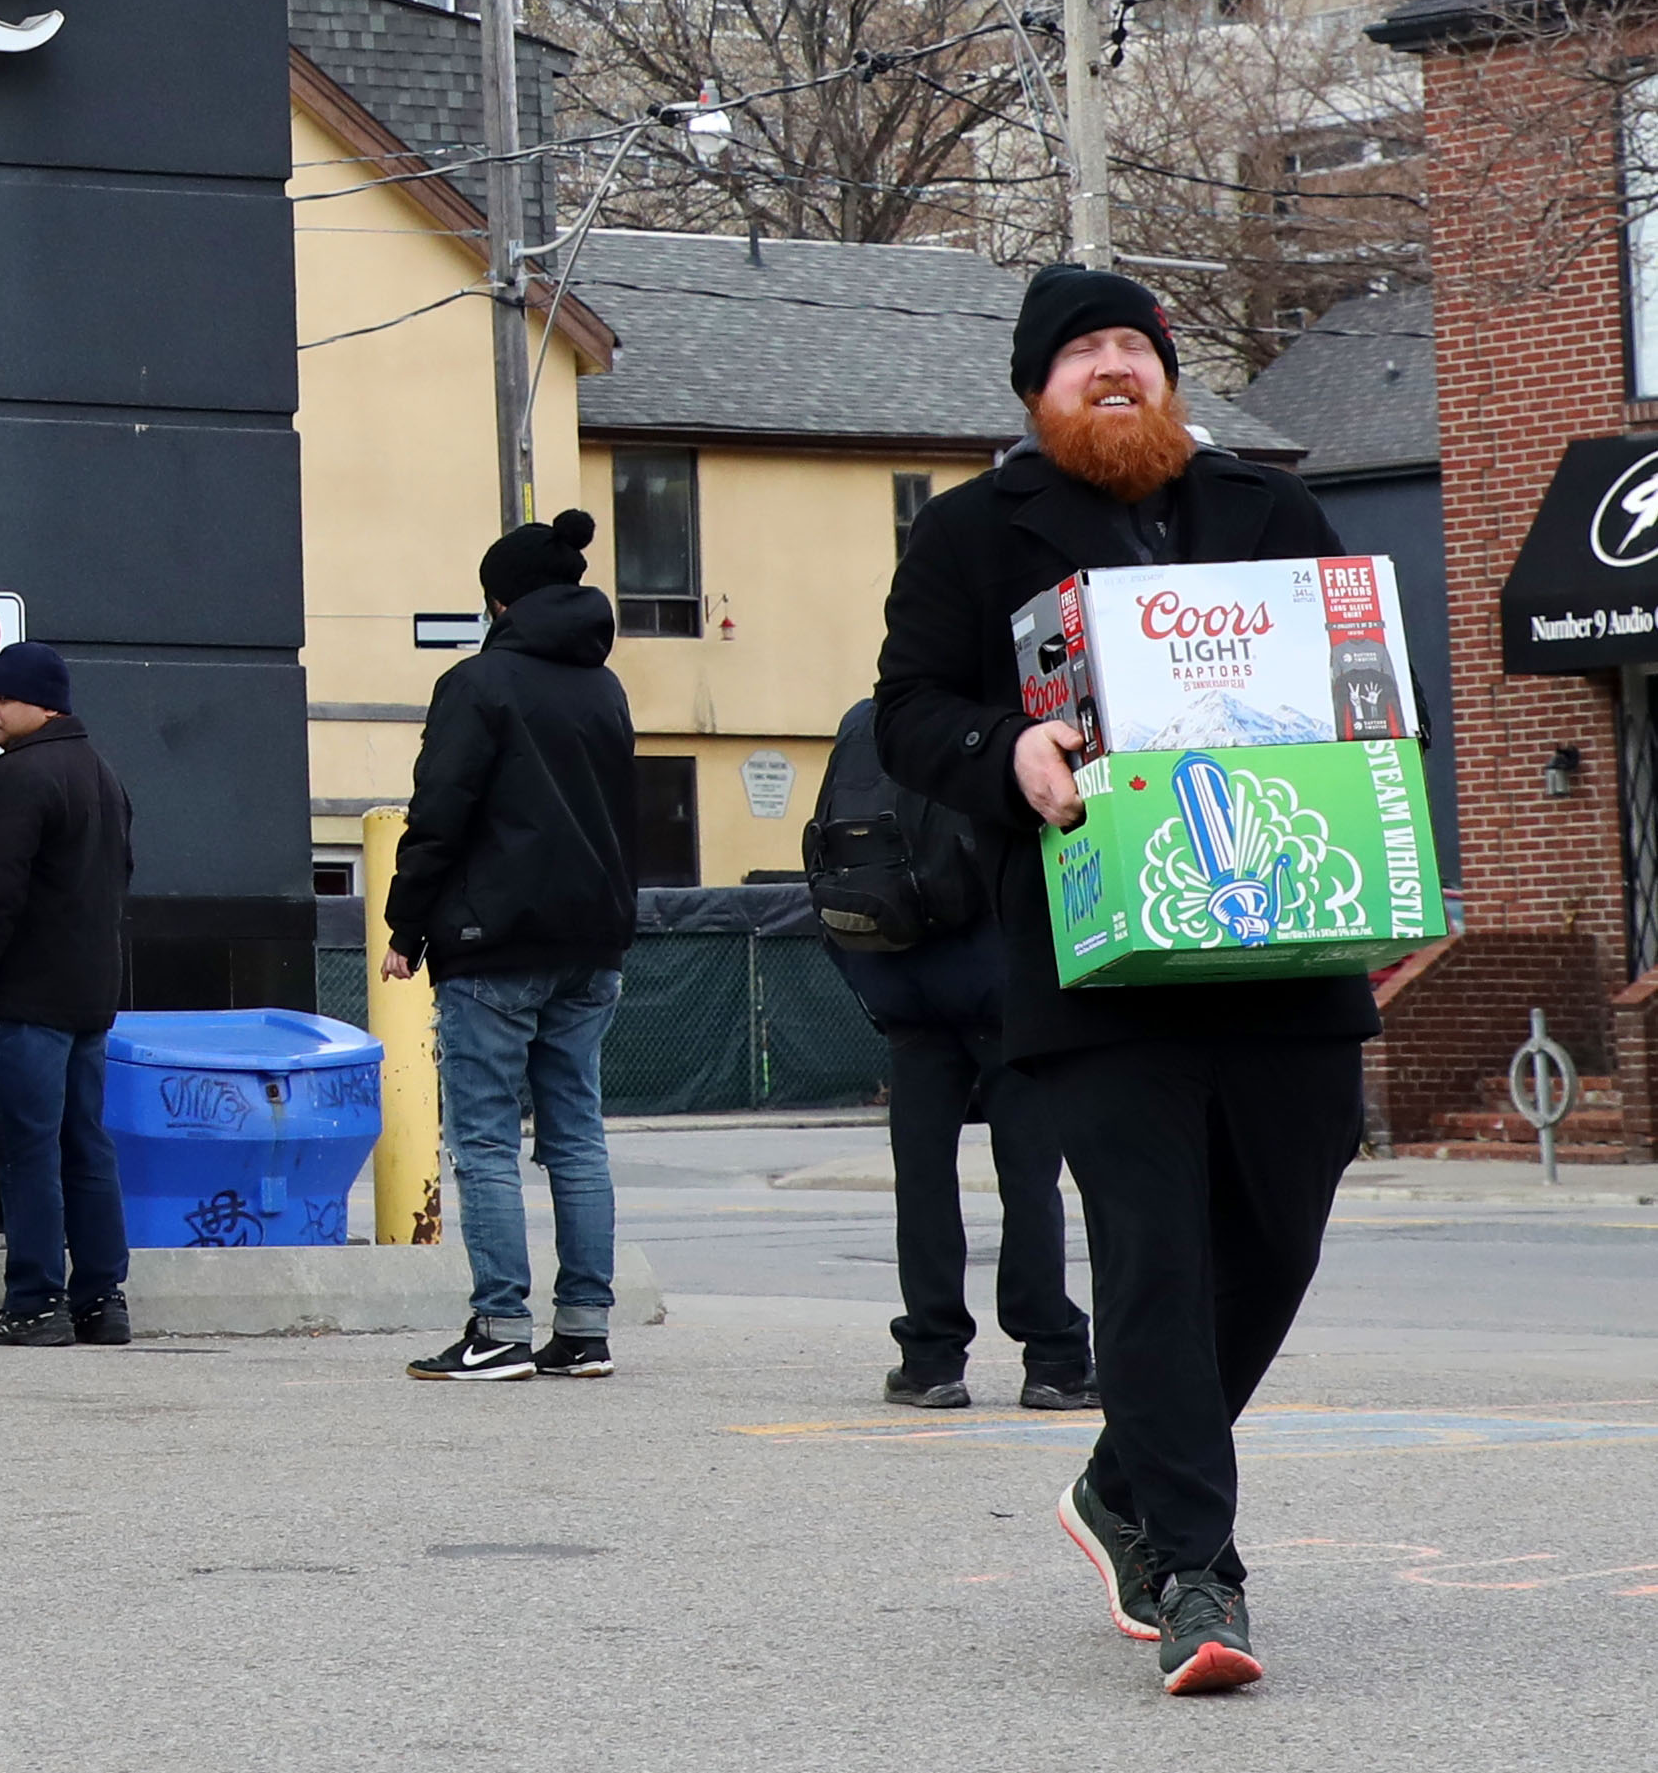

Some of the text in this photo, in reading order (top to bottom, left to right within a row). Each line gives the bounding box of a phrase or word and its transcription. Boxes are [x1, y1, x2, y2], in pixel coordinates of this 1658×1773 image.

[1292, 571, 1311, 584] 24
[1324, 567, 1371, 588] FREE
[1061, 586, 1079, 611] FREE
[1327, 586, 1373, 598] RAPTORS
[1135, 590, 1275, 640] Coors
[1349, 603, 1373, 612] SLEEVE
[1531, 605, 1654, 642] Number 9 Audio
[1169, 637, 1253, 664] LIGHT
[1172, 664, 1253, 680] RAPTORS
[1022, 673, 1070, 719] Coors
[1363, 740, 1413, 823] STEAM
[1063, 837, 1090, 864] PURE
[1061, 848, 1103, 934] Pilsner
[1383, 825, 1425, 940] WHISTLE
